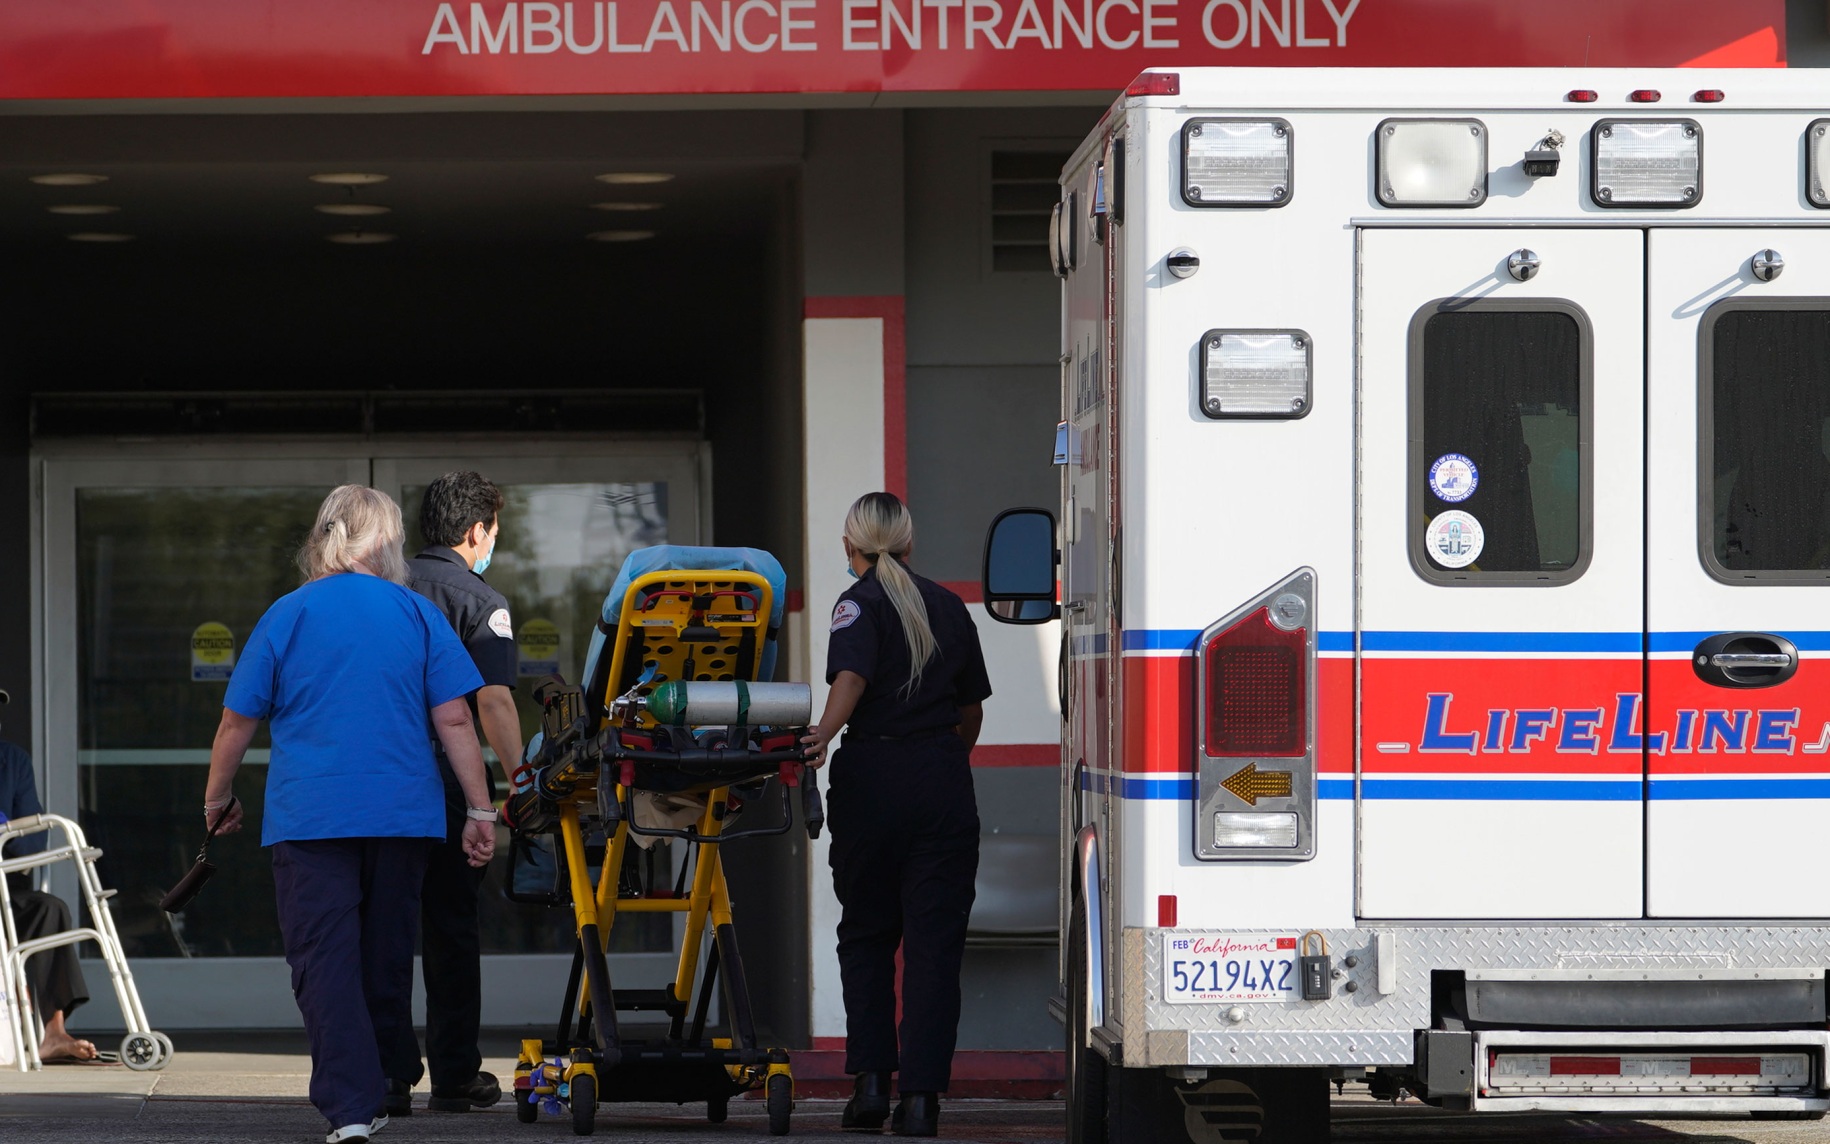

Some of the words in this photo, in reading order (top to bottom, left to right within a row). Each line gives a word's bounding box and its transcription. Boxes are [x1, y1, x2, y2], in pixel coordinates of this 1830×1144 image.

[421, 0, 818, 55] AMBULANCE
[841, 0, 1180, 51] ENTRANCE
[1201, 0, 1361, 49] ONLY
[194, 638, 232, 649] CAUTION
[1173, 940, 1189, 950] FEB
[1193, 937, 1277, 958] California
[1173, 959, 1293, 992] 52194X2
